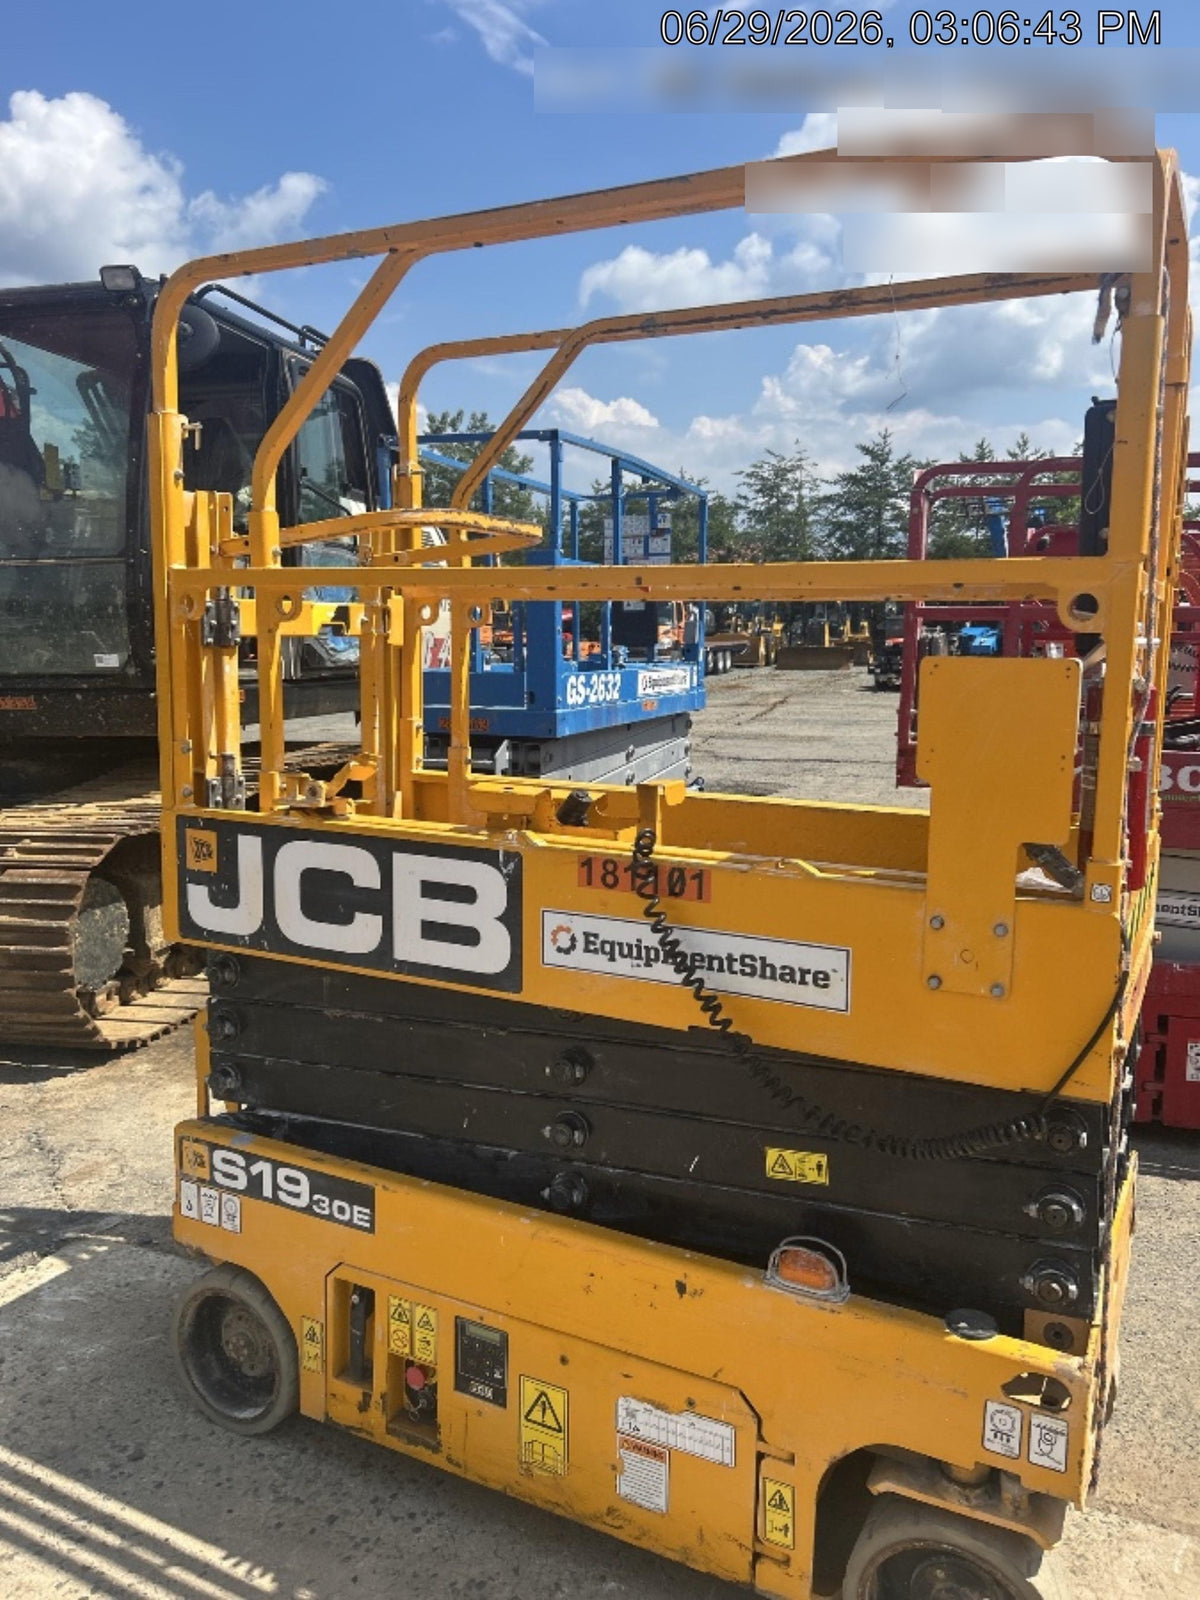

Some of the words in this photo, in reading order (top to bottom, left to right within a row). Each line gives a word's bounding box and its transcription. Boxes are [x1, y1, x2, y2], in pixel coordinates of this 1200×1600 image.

[566, 673, 622, 705] GS-2632
[187, 833, 512, 975] JCB
[1156, 903, 1200, 917] entS
